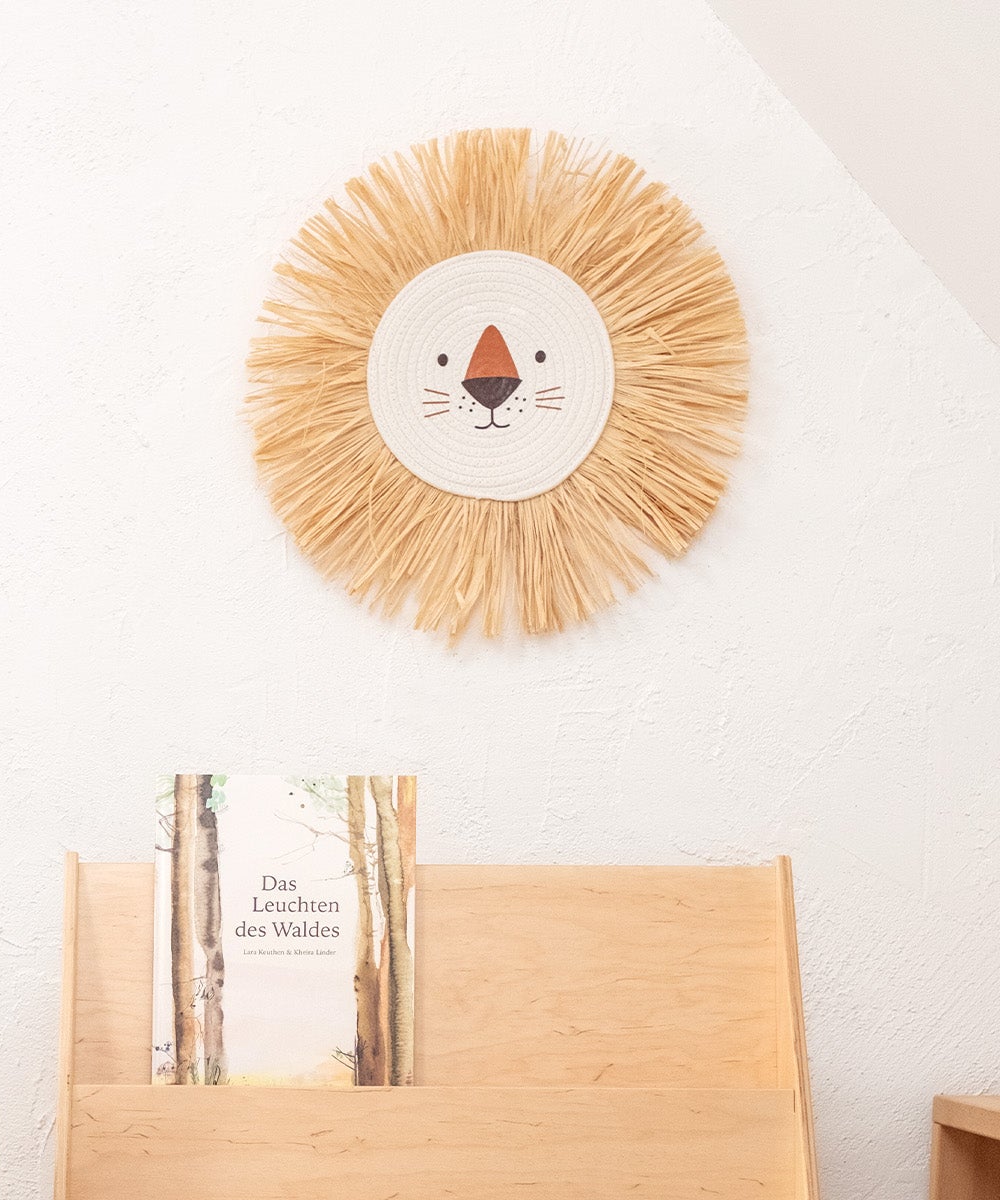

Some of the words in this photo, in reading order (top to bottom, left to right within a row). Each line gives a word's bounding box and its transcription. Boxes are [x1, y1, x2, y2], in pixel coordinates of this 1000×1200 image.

[261, 875, 297, 891] Das
[252, 896, 340, 913] Leuchten
[235, 921, 267, 938] des
[271, 921, 340, 938] Waldes
